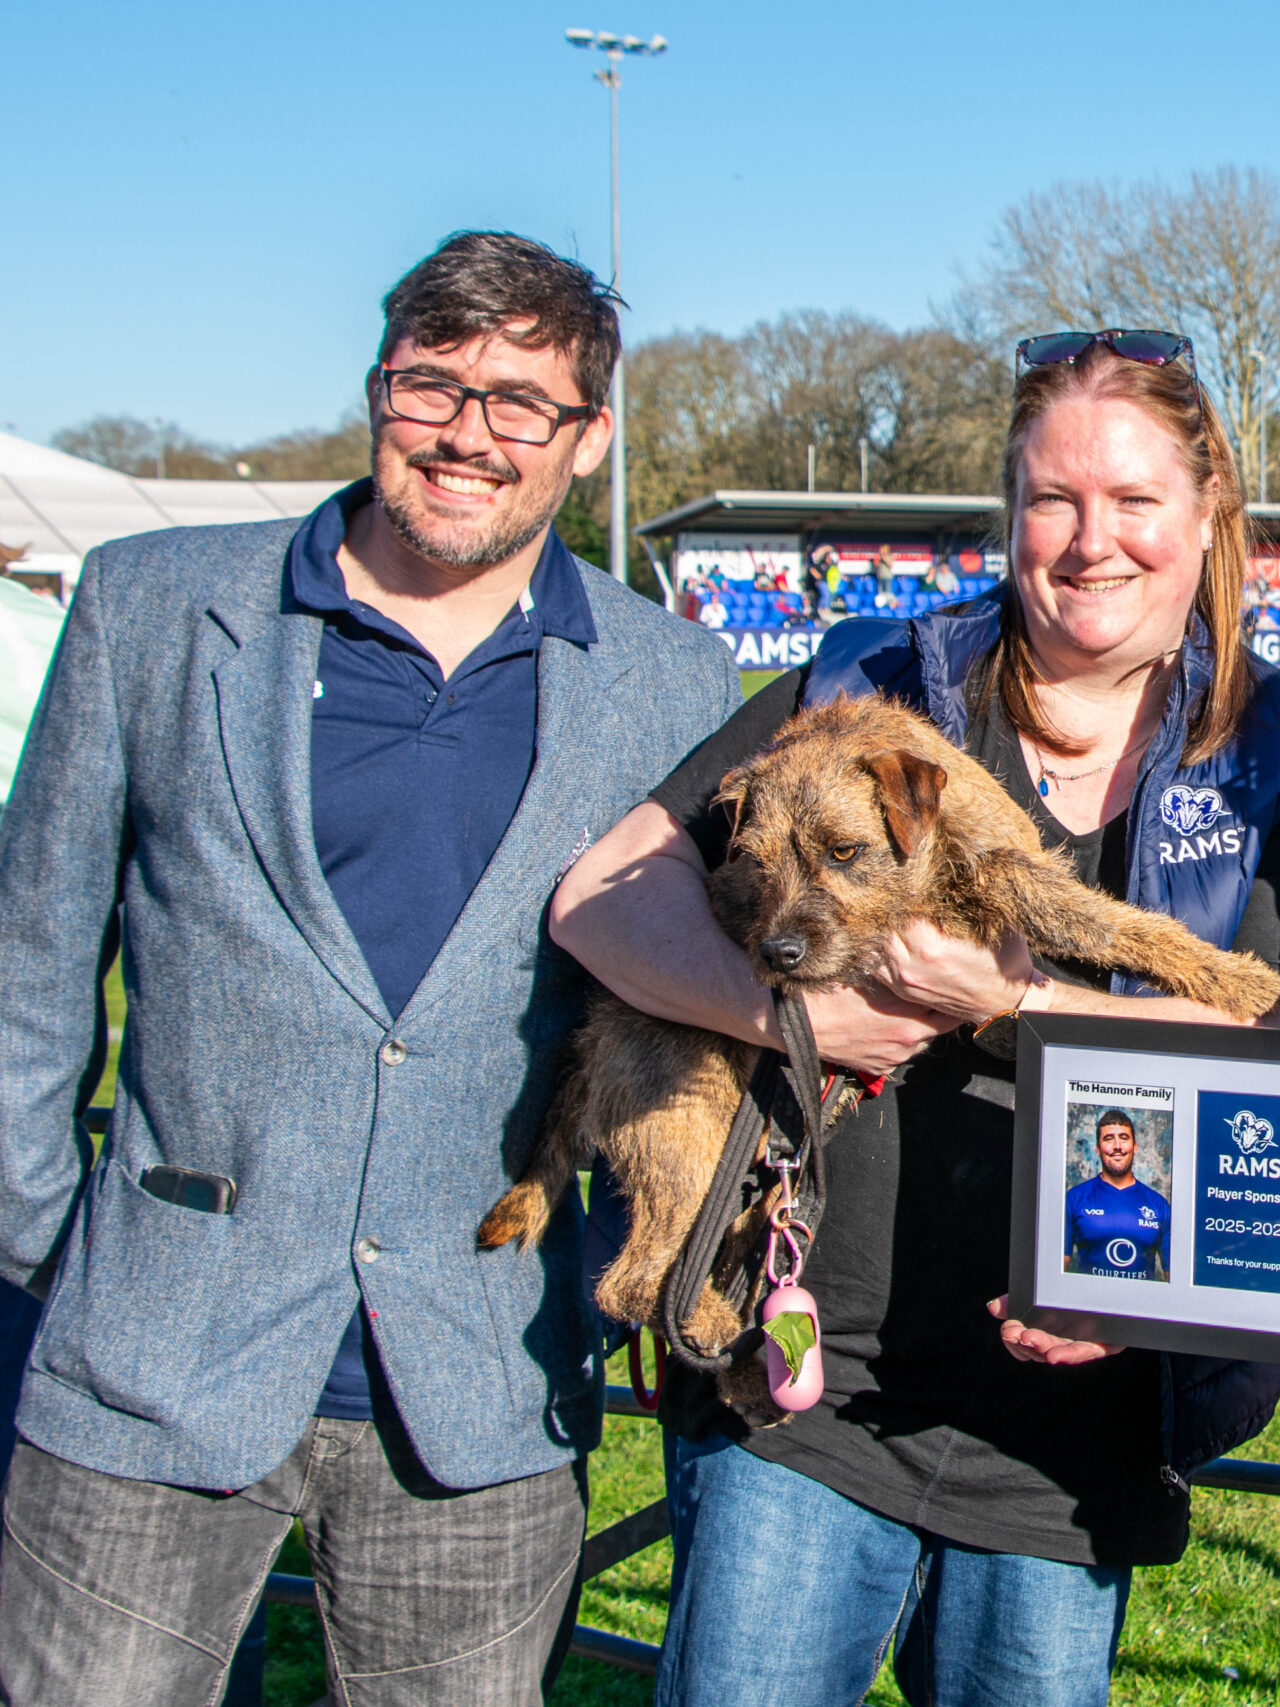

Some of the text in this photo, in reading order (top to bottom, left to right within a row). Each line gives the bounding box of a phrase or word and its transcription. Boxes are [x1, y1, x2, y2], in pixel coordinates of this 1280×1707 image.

[1159, 829, 1241, 865] RAMS
[1069, 1082, 1172, 1101] The Hannon Family
[1207, 1186, 1243, 1202] Player
[1138, 1219, 1159, 1230] RAMS
[1206, 1255, 1233, 1266] Thanks
[1234, 1258, 1244, 1267] for
[1245, 1260, 1262, 1270] your
